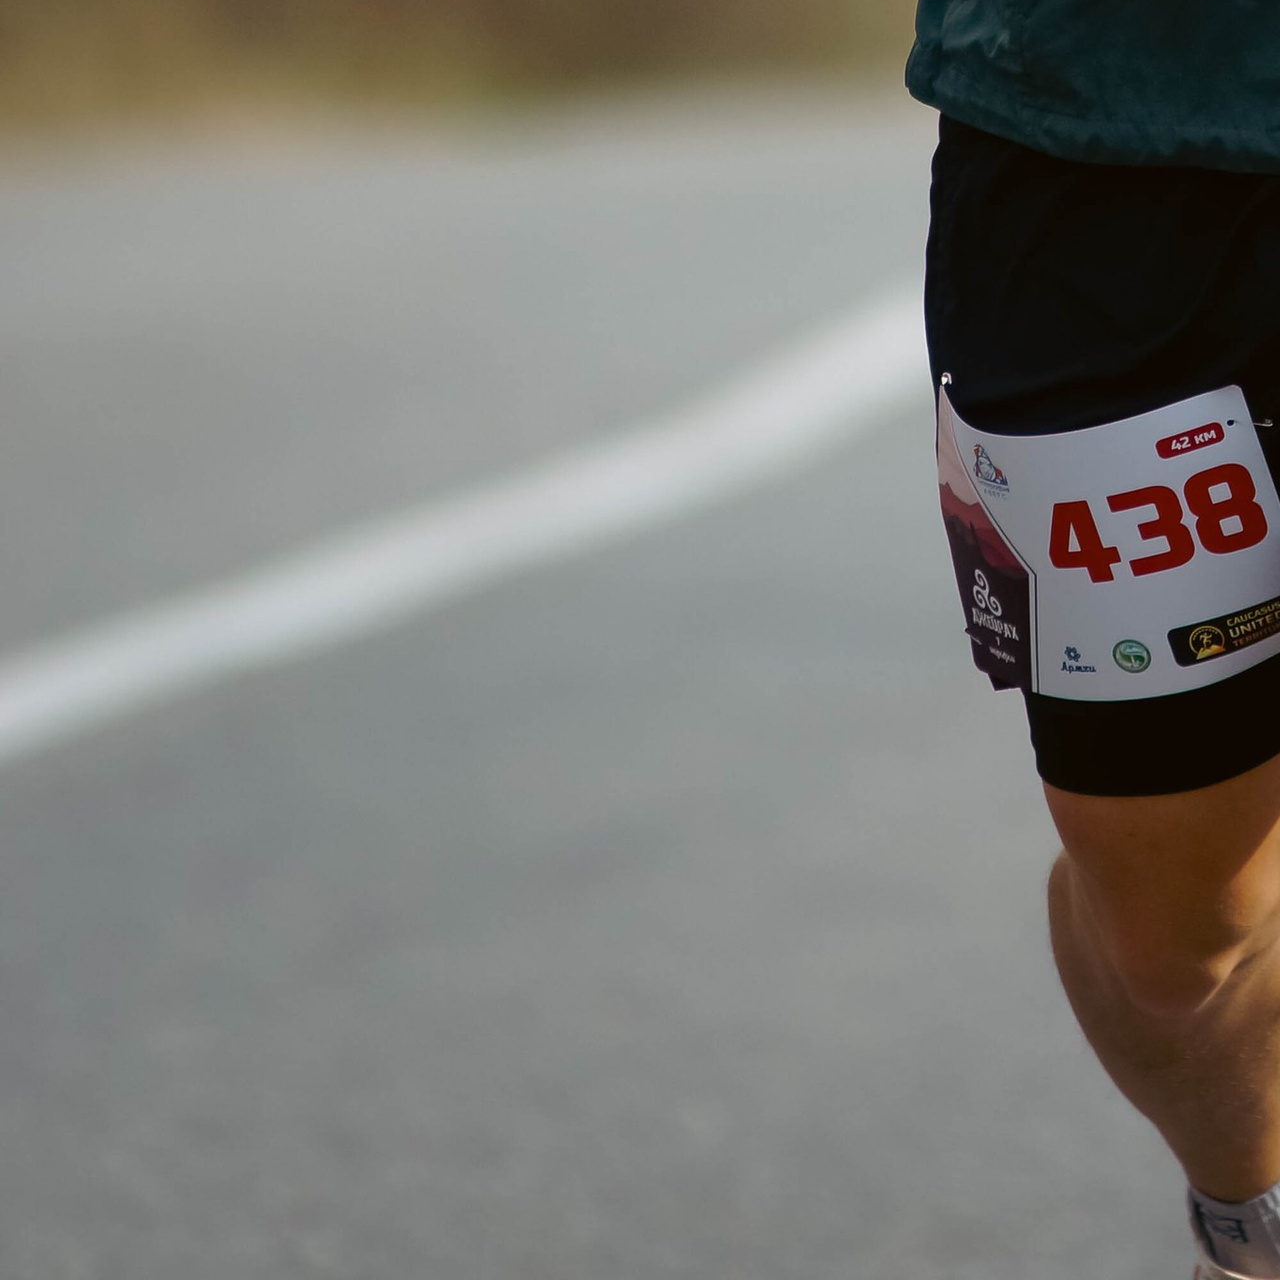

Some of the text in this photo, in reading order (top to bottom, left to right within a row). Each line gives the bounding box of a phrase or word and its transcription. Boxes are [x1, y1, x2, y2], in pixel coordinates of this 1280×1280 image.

[1171, 430, 1217, 450] 42 KM
[1049, 463, 1268, 583] 438
